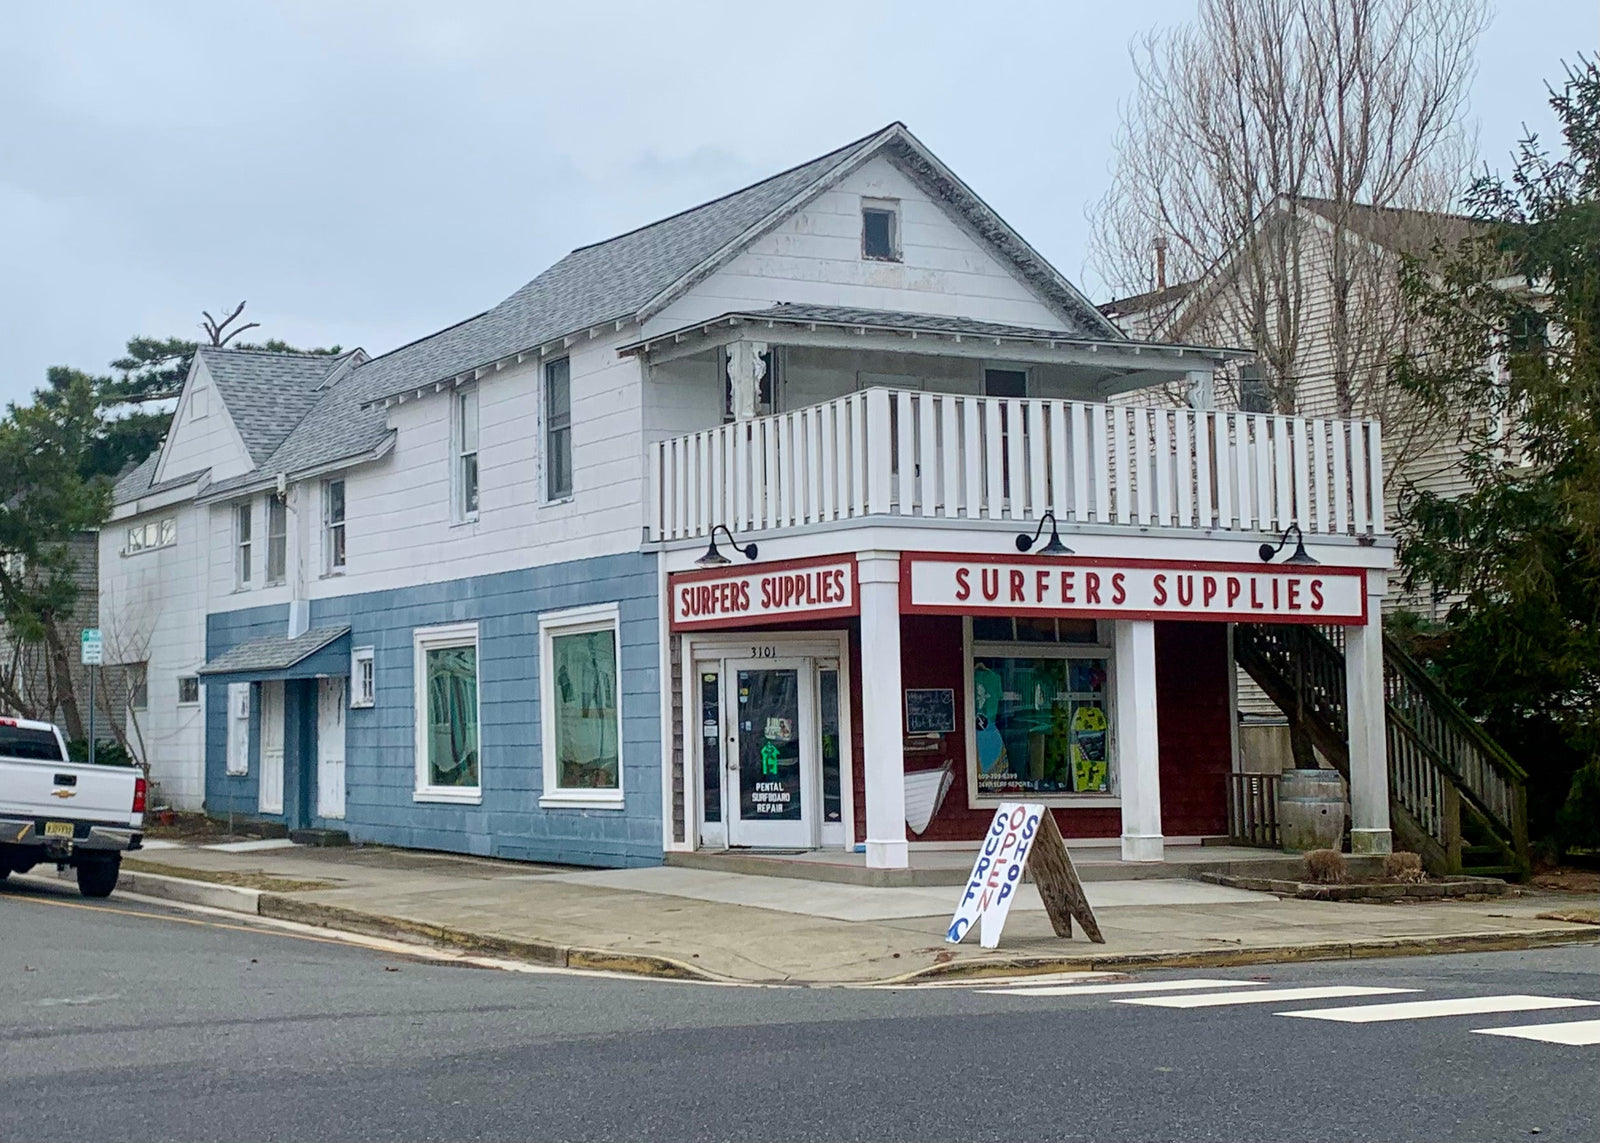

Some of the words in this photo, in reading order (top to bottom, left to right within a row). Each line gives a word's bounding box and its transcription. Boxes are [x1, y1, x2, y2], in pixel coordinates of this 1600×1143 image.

[681, 580, 750, 617] SURFERS
[760, 569, 845, 609] SUPPLIES
[956, 567, 1126, 605] SURFERS
[1153, 574, 1324, 611] SUPPLIES
[751, 646, 776, 659] 3101
[756, 803, 784, 814] REPAIR
[962, 813, 1009, 907] SURF
[976, 806, 1026, 912] OPEN
[997, 815, 1038, 906] SHOP
